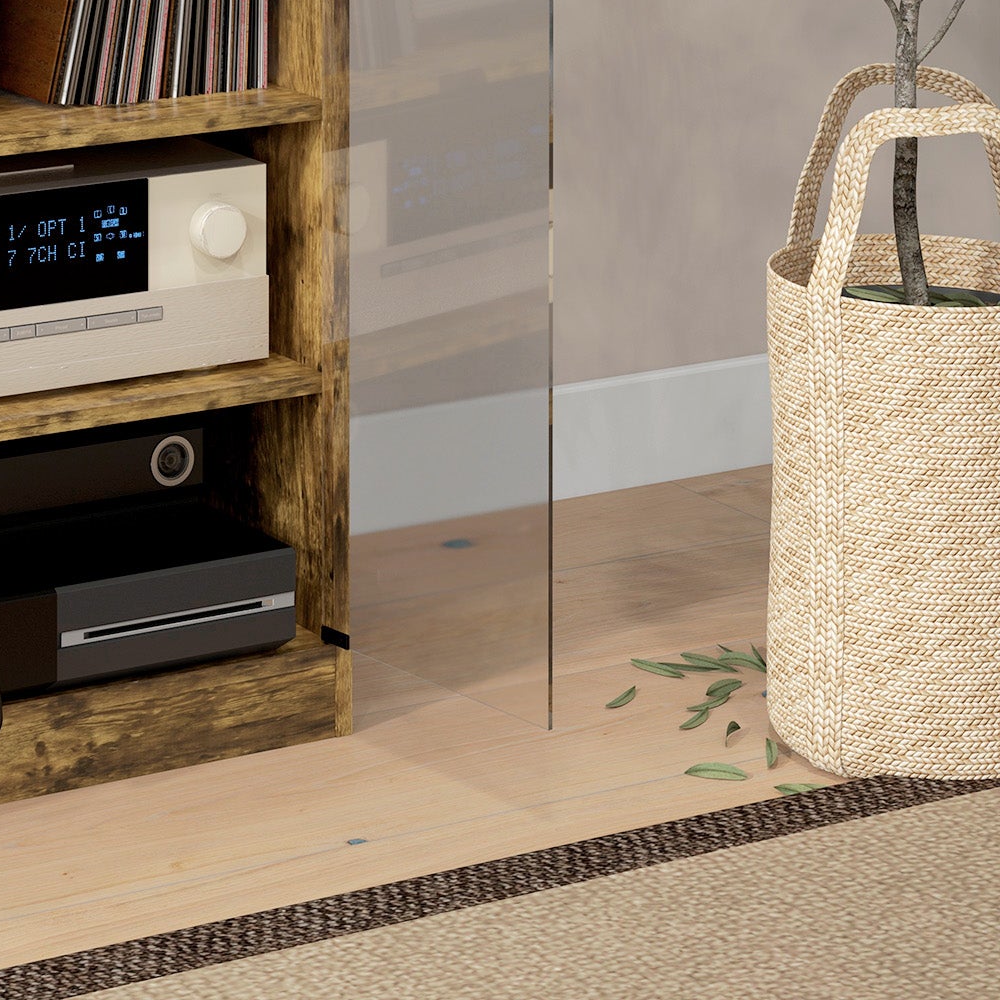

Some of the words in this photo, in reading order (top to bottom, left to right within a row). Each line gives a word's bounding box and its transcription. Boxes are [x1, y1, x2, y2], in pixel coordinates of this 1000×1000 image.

[9, 225, 26, 241] 1/
[38, 219, 66, 237] OPT
[80, 217, 85, 232] 1
[8, 250, 16, 266] 7
[28, 245, 56, 263] 7CH
[68, 241, 85, 258] CI
